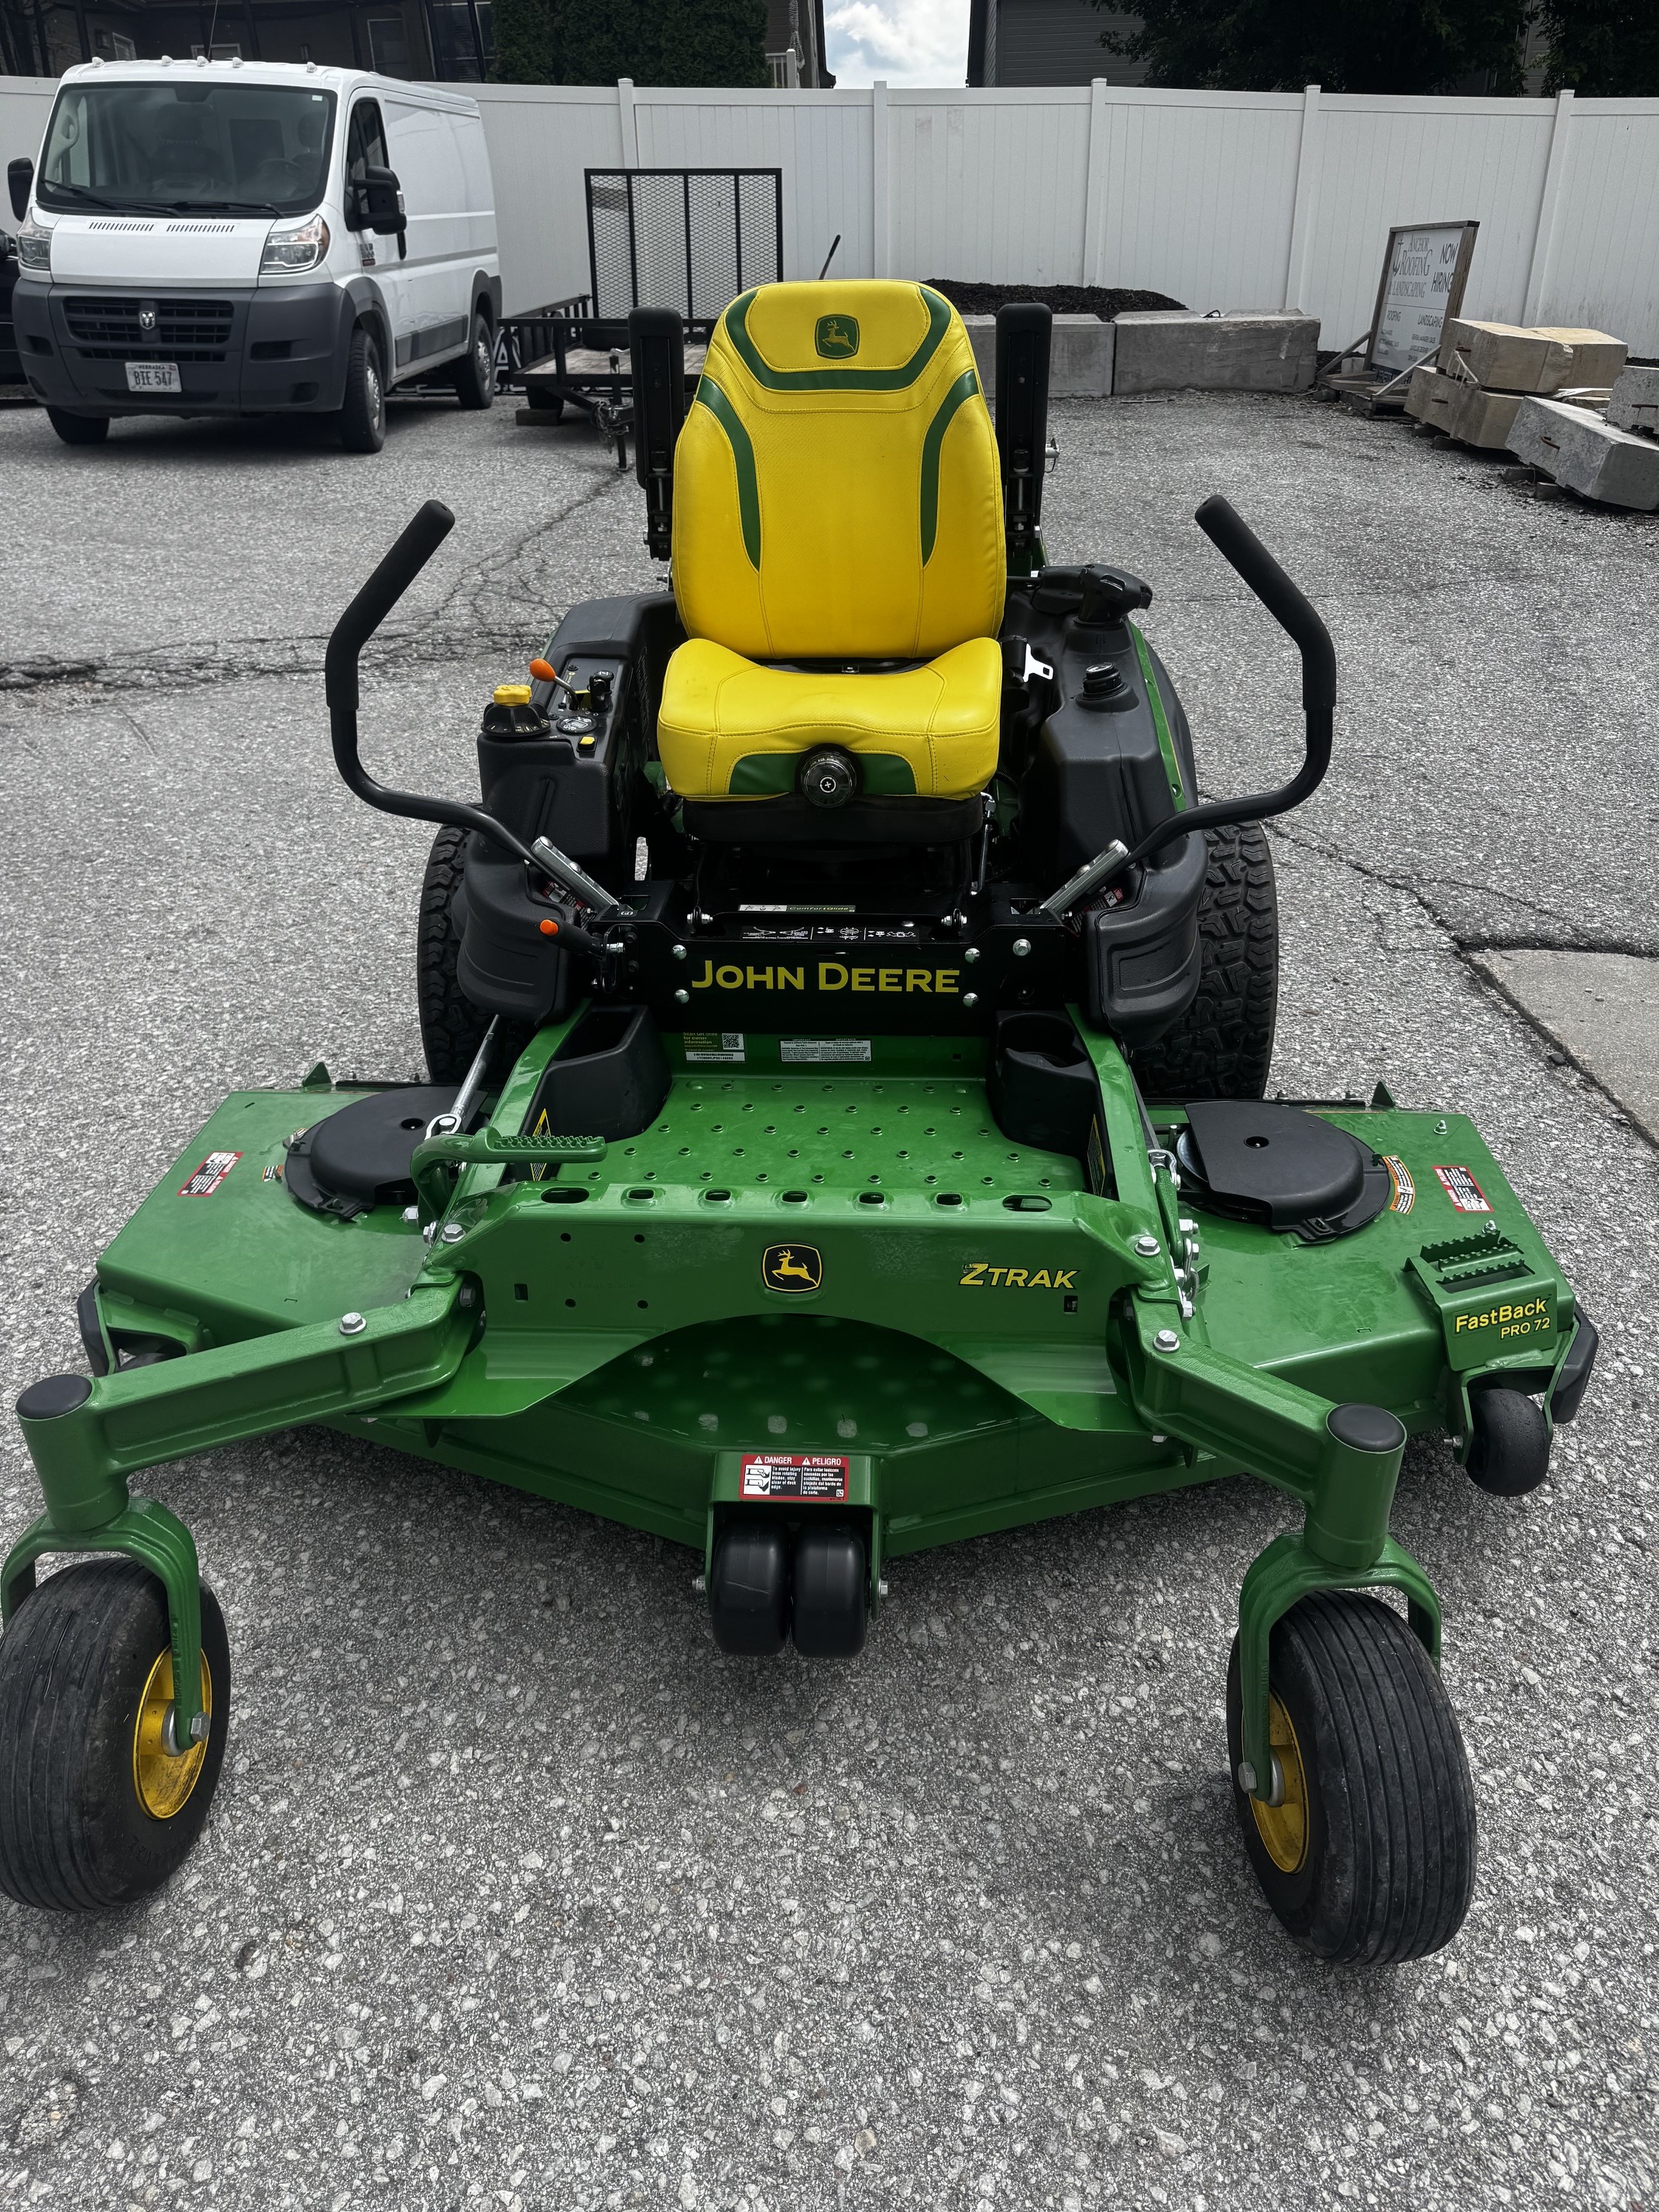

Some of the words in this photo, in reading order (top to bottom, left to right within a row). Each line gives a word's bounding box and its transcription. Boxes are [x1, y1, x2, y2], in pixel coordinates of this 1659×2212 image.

[1407, 233, 1430, 252] ANCHOR
[1440, 242, 1458, 264] NOW
[1399, 249, 1433, 276] ROOFING
[1392, 280, 1427, 298] LANDSCAPING
[1431, 272, 1454, 294] HIRING
[1417, 314, 1443, 328] LANDSCAPING
[134, 370, 153, 386] BIE
[155, 371, 172, 386] 547
[692, 960, 804, 991] JOHN
[818, 962, 960, 993] DEERE
[960, 1262, 1078, 1290] ZTRAK
[1456, 1298, 1547, 1333] FastBack
[1500, 1322, 1530, 1339] PRO
[1534, 1317, 1550, 1331] 72
